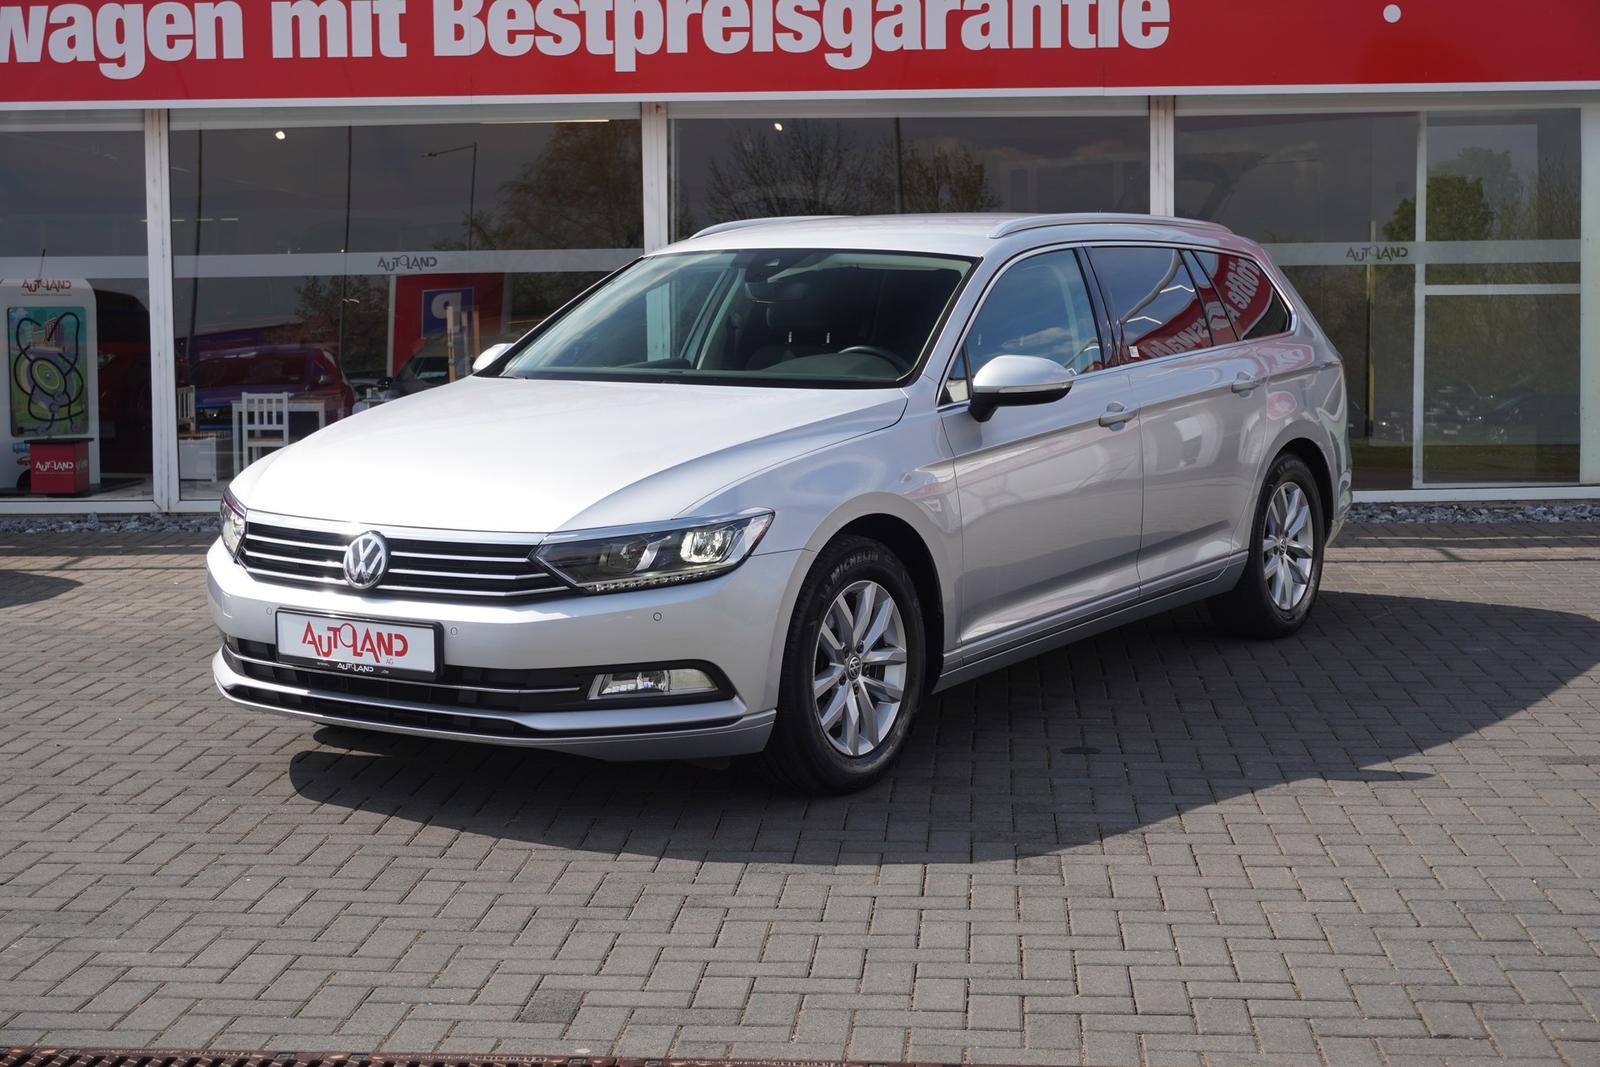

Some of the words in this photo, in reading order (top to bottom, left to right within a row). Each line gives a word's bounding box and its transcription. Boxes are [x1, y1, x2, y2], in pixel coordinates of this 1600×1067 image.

[271, 0, 408, 59] mit
[433, 0, 1171, 72] Bestpreisgarantie
[1345, 246, 1409, 262] AUTOLAND
[377, 255, 438, 272] AUTOLAND
[35, 460, 74, 472] AUTOLAND
[830, 551, 880, 585] MICHELIN
[301, 621, 409, 663] AUTOLAND
[337, 663, 374, 673] AUTOLAND
